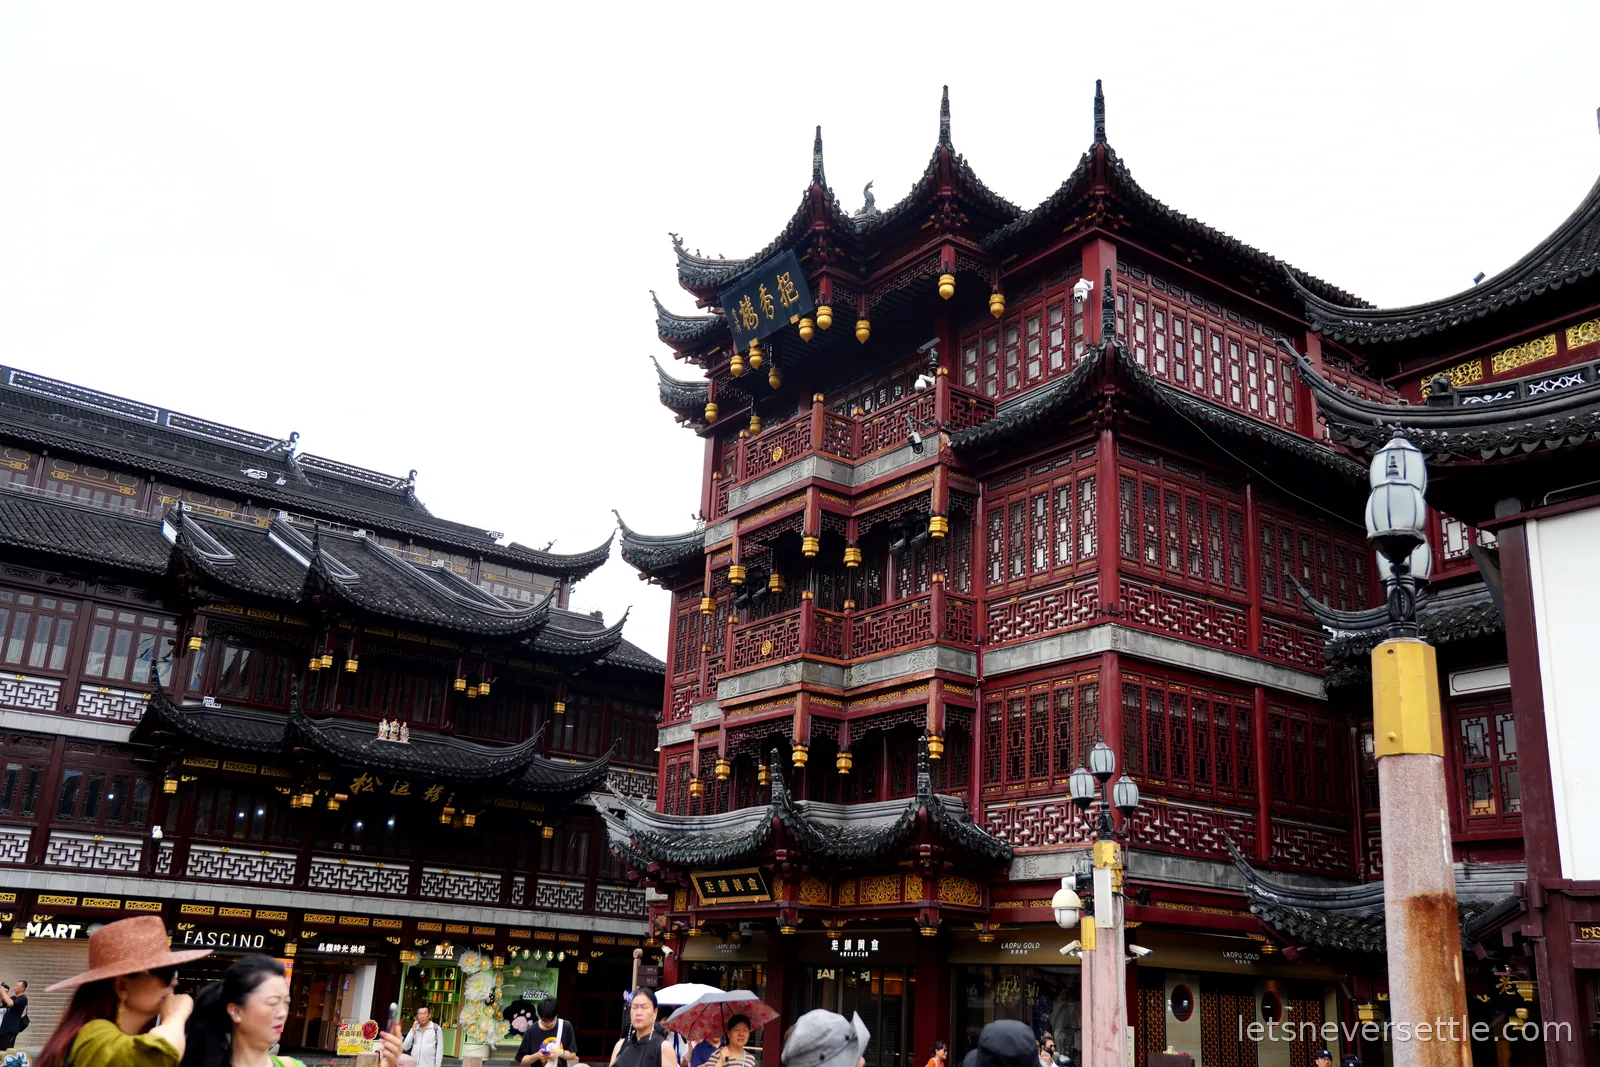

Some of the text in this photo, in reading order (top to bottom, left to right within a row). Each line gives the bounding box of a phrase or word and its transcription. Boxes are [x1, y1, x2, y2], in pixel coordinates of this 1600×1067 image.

[25, 922, 82, 939] MART
[184, 930, 265, 948] FASCINO
[1222, 951, 1259, 961] LAOPU GOLD
